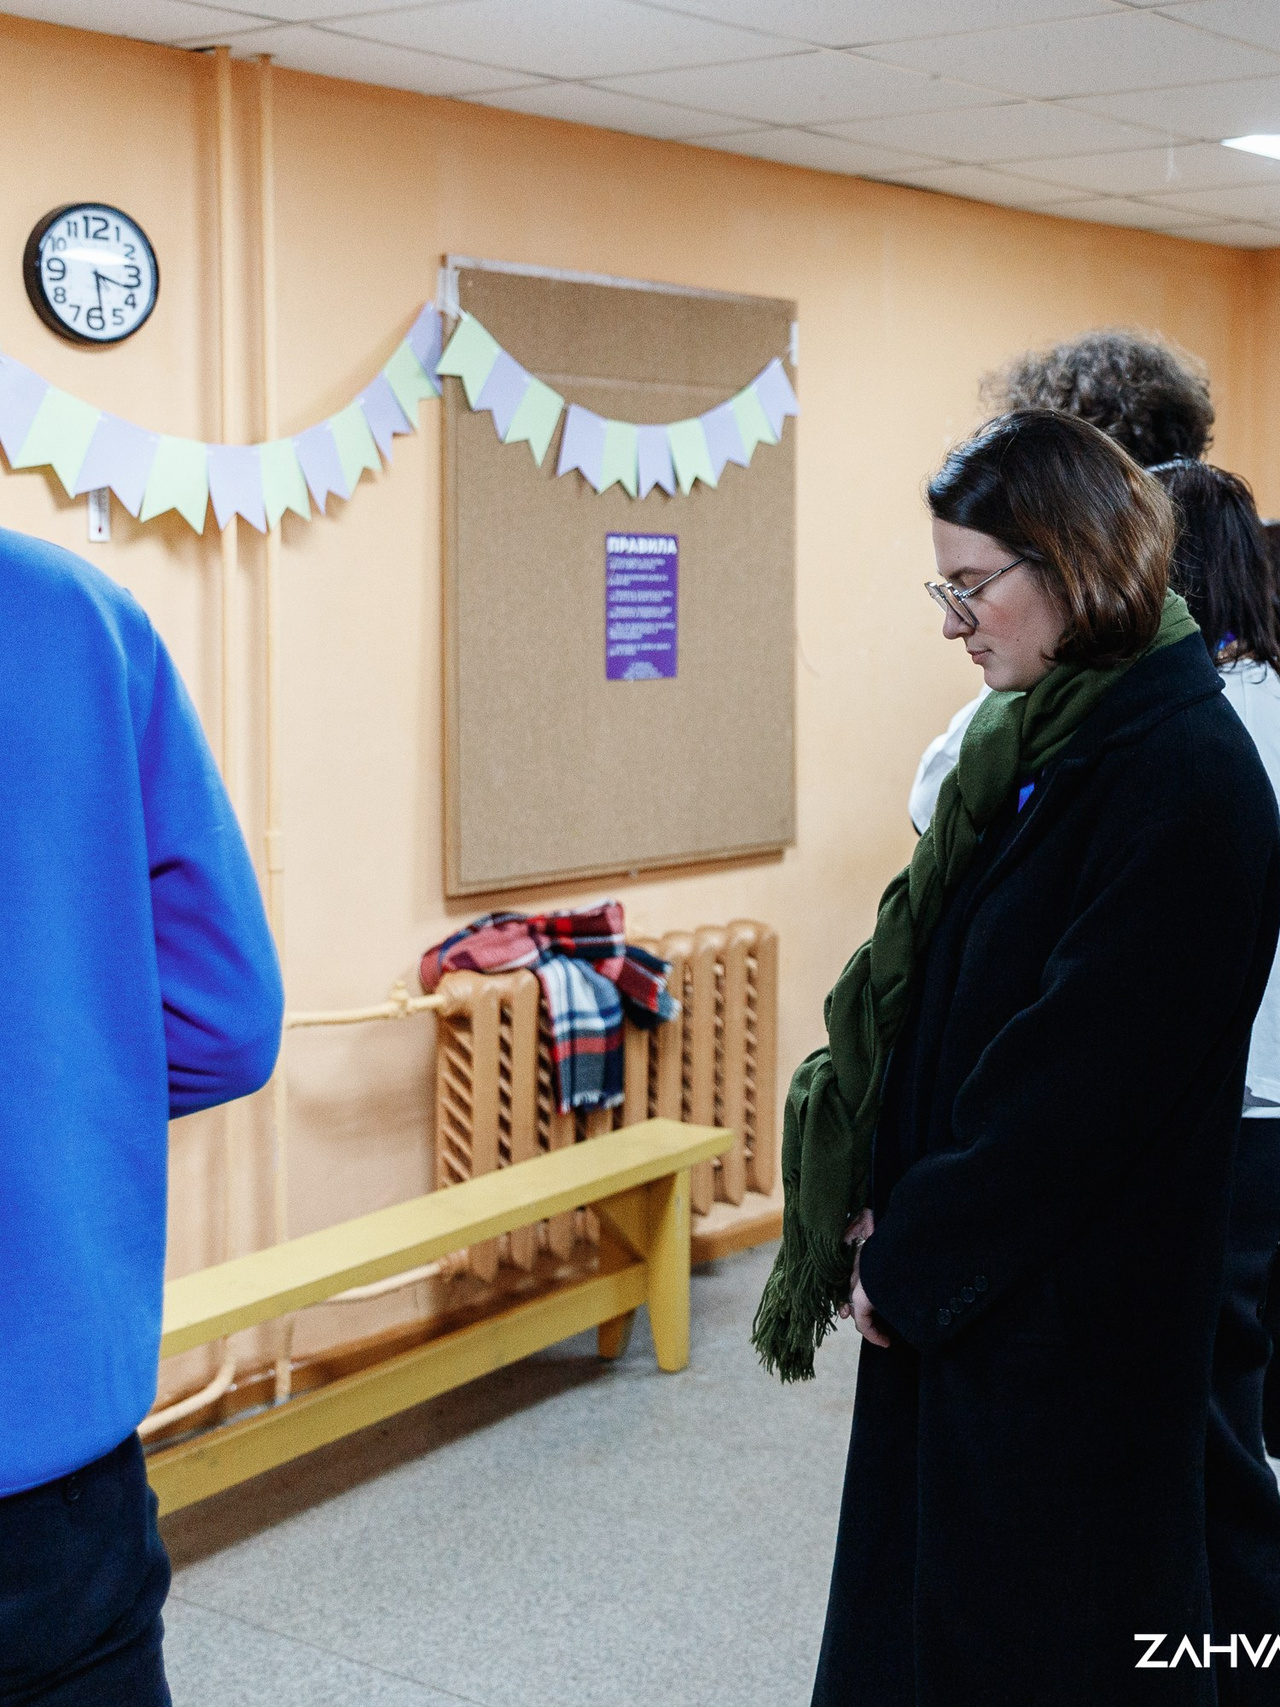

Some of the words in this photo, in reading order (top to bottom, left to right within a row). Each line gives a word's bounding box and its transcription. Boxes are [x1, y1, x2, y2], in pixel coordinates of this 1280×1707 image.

[66, 221, 78, 238] 11
[82, 215, 109, 240] 12
[115, 226, 121, 242] 1
[48, 236, 66, 252] 10
[123, 243, 136, 260] 2
[46, 257, 66, 281] 9
[124, 264, 141, 289] 3
[53, 286, 66, 304] 8
[124, 293, 137, 309] 4
[69, 304, 81, 322] 7
[86, 307, 105, 330] 6
[112, 308, 125, 326] 5
[607, 536, 677, 555] ПРАВИЛА
